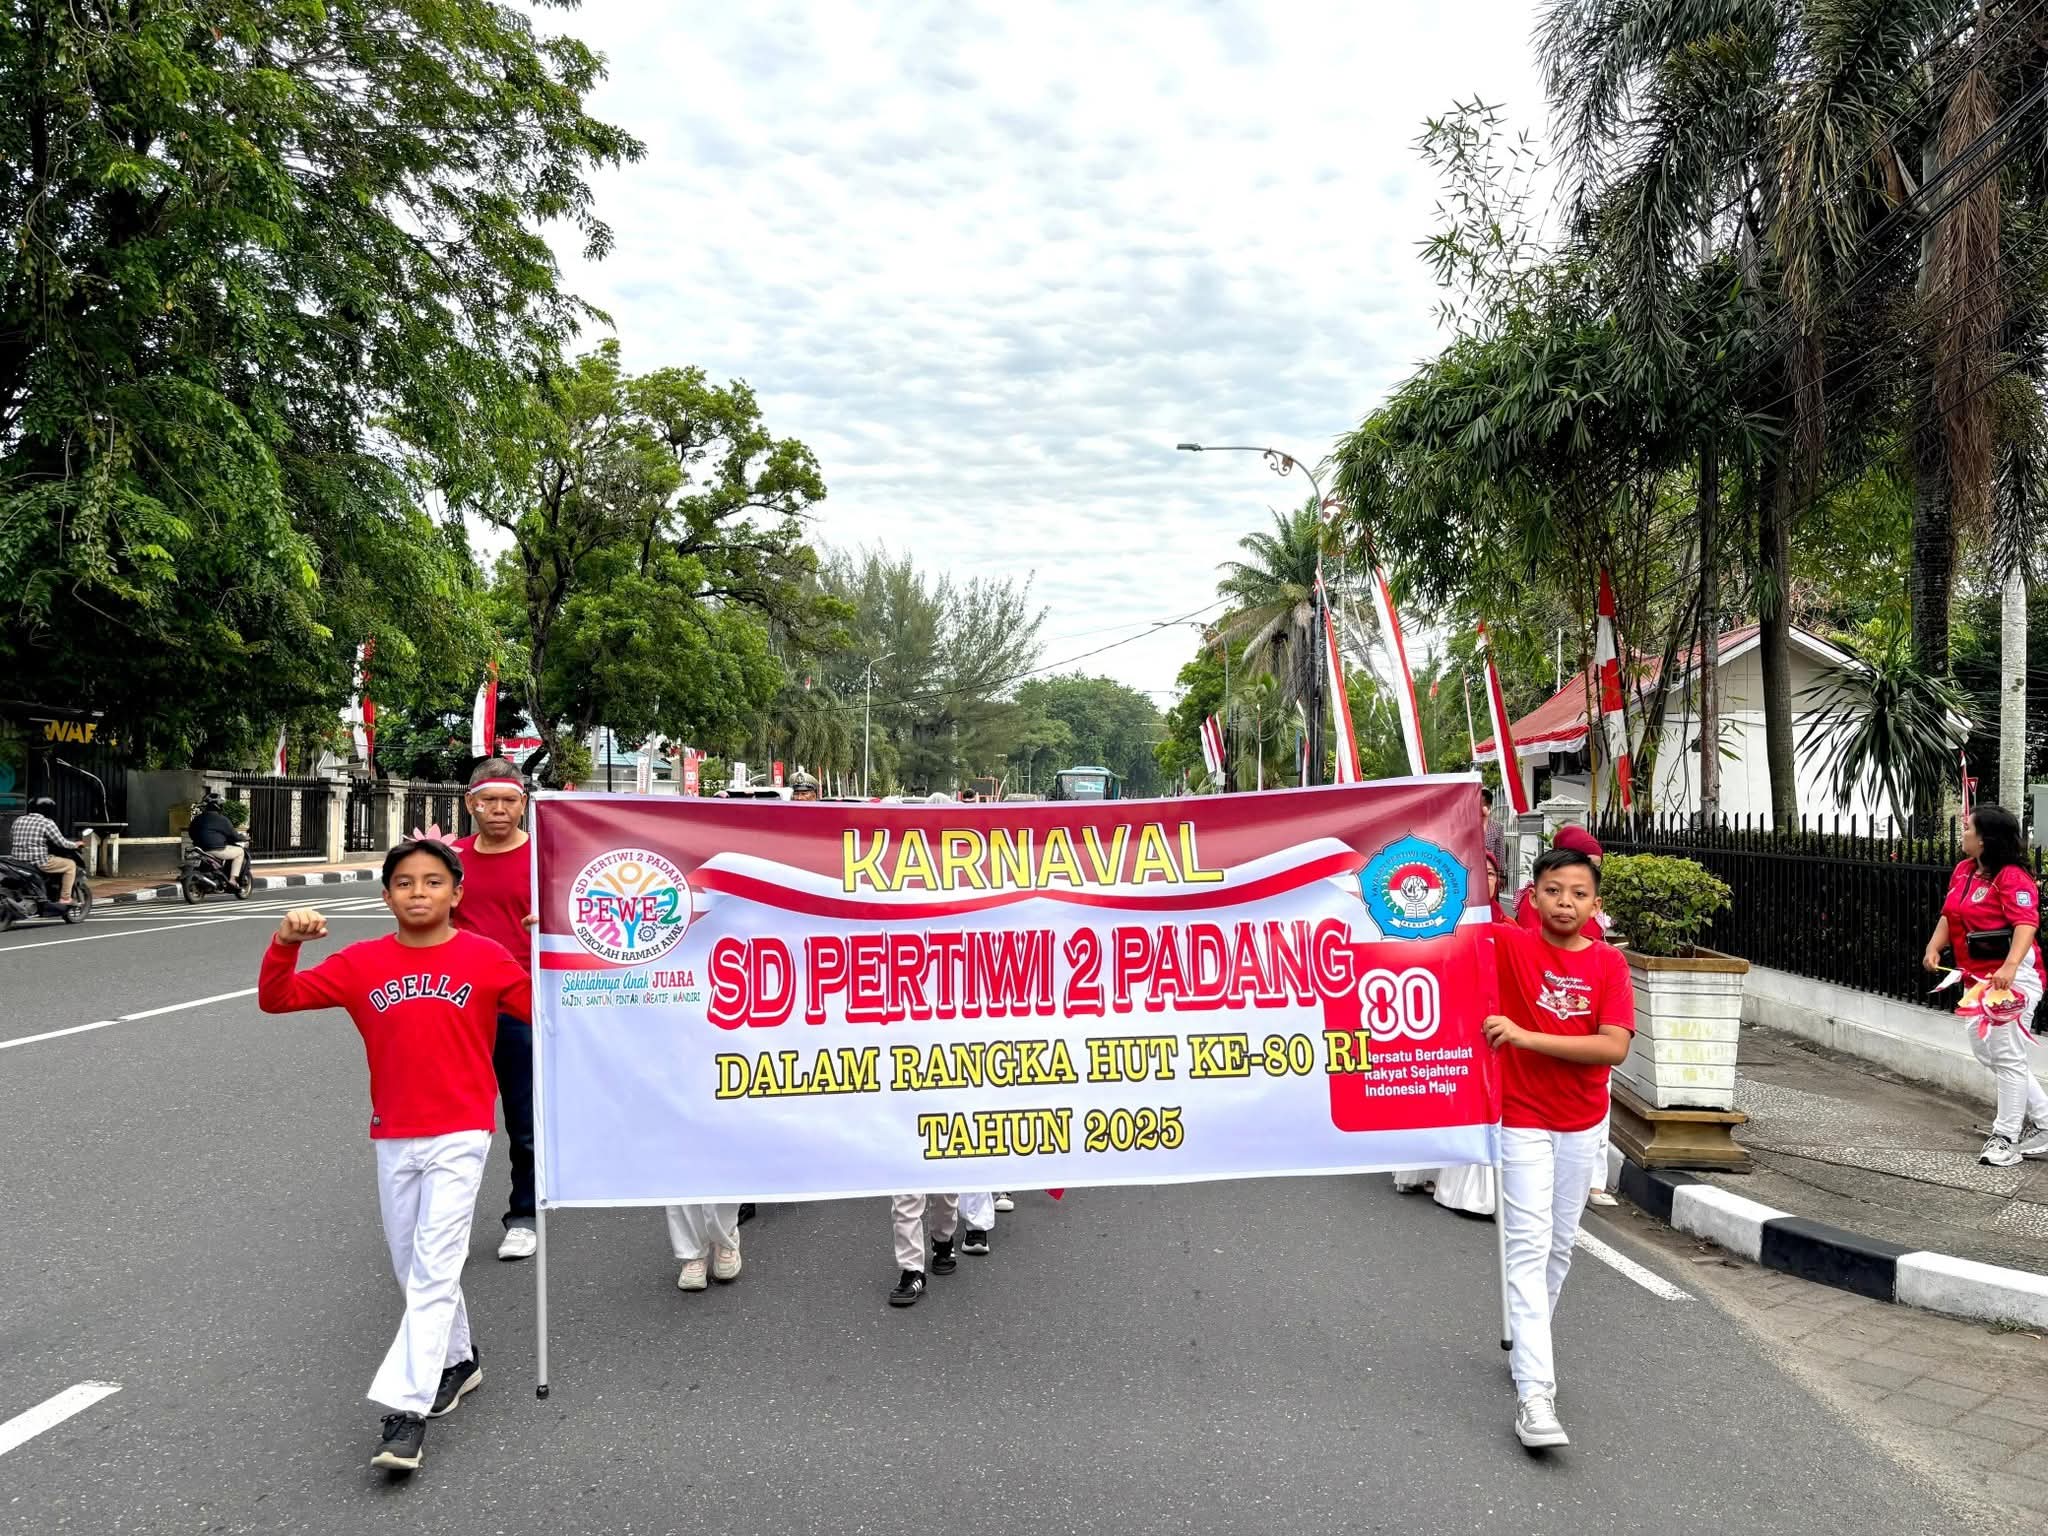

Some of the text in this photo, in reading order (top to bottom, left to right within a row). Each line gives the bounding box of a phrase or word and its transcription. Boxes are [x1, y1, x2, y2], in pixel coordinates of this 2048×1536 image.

[575, 852, 686, 895] SD PERTIWI 2 PADANG
[842, 822, 1224, 892] KARNAVAL
[577, 924, 684, 961] SEKOLAH RAMAH ANAK
[369, 974, 473, 1012] OSELLA
[562, 970, 695, 993] Sekolahnya Anak JUARA
[707, 918, 1357, 1030] SD PERTIWI 2 PADANG
[1358, 966, 1440, 1042] 80
[715, 1030, 1373, 1100] DALAM RANGKA HUT KE-80 RI
[1364, 1064, 1469, 1082] Rakyat Sejahtera
[1415, 1046, 1473, 1062] Berdaulat
[1365, 1080, 1457, 1096] Indonesia Maju
[918, 1107, 1184, 1159] TAHUN 2025
